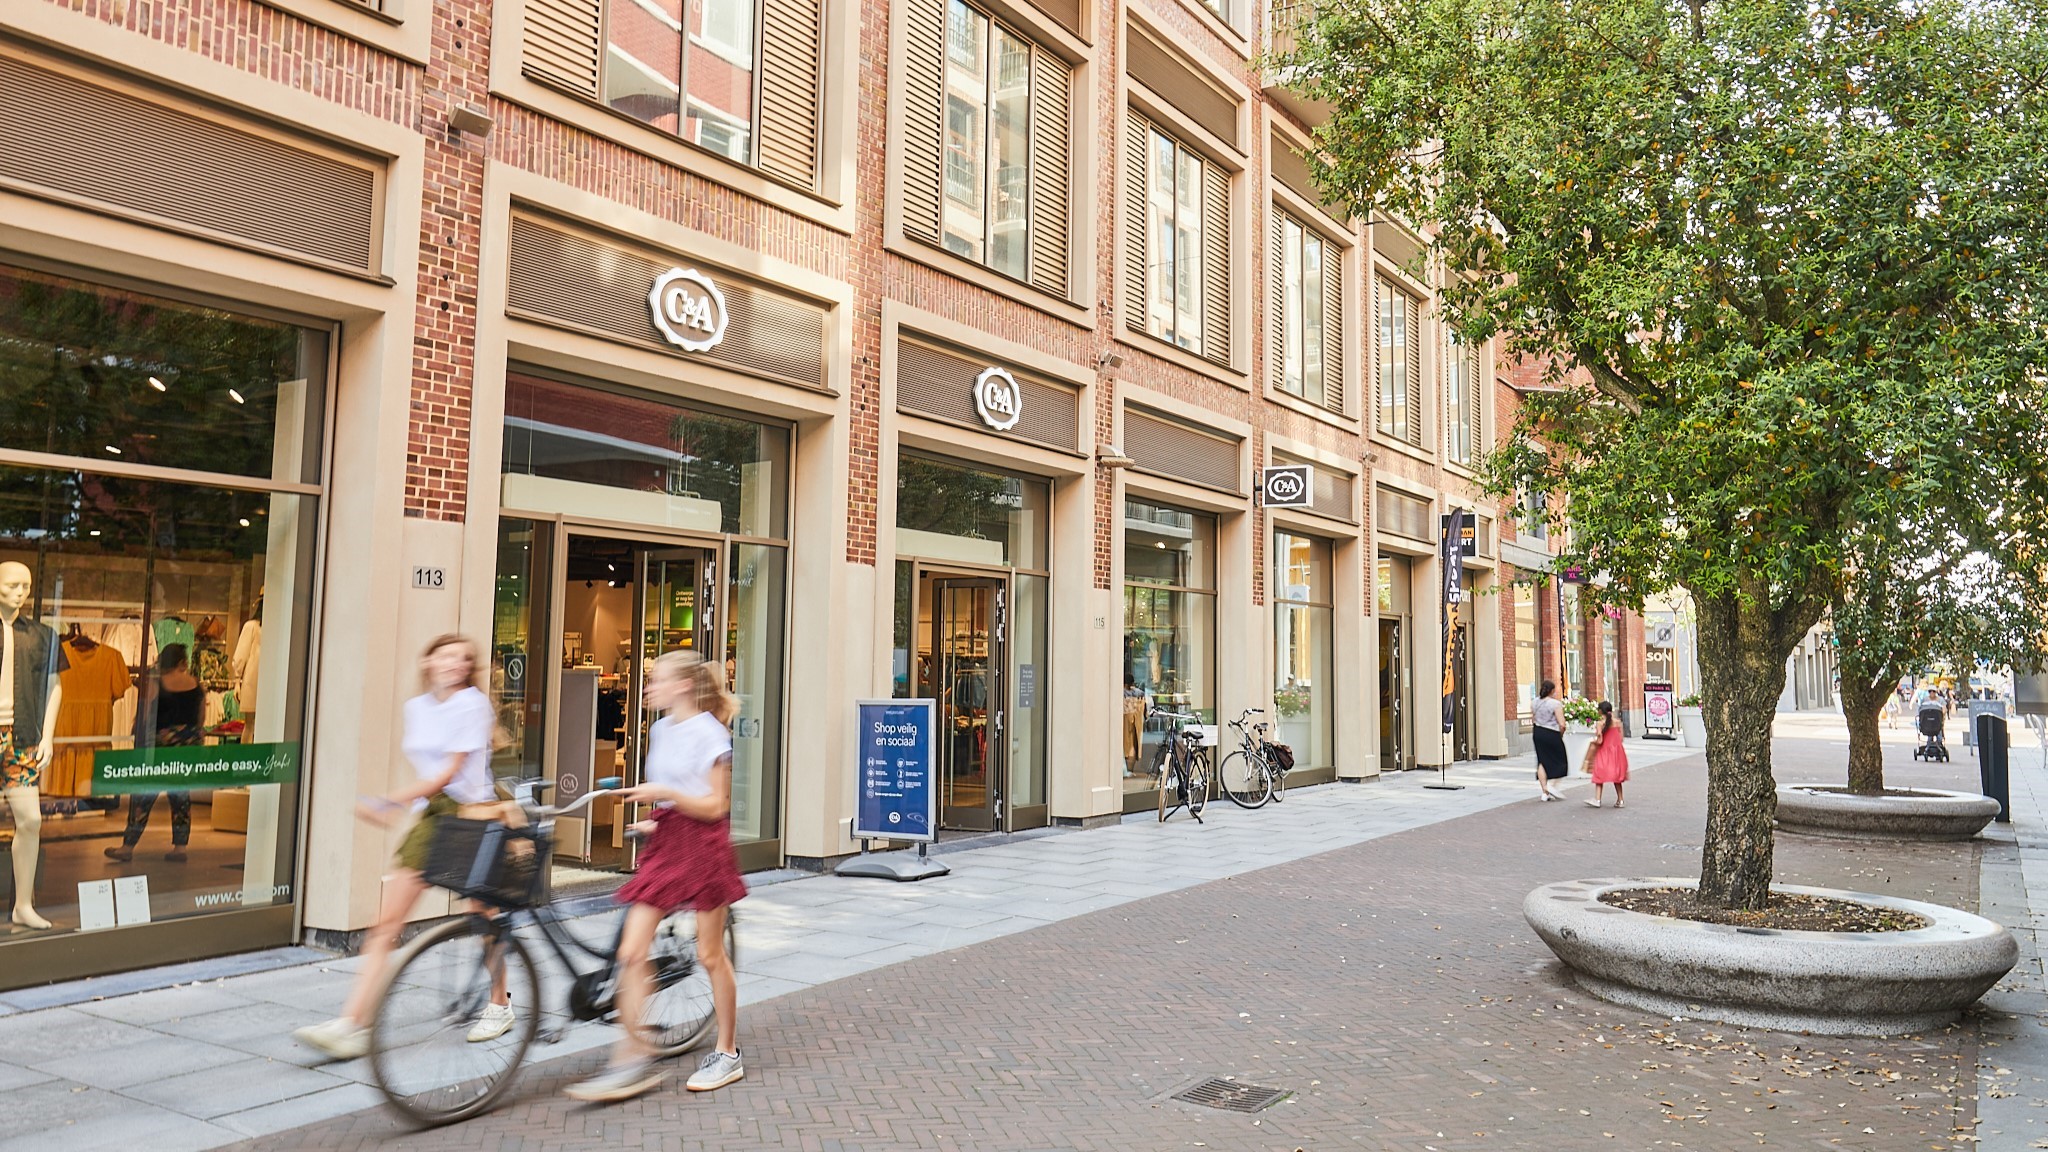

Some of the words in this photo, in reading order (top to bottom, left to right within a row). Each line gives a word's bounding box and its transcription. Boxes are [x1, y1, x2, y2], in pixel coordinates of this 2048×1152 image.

[665, 287, 716, 333] C&A
[984, 382, 1014, 415] C&A
[1274, 479, 1297, 493] C&A
[416, 568, 443, 586] 113
[1095, 617, 1105, 627] 115
[874, 721, 896, 735] Shop
[897, 722, 917, 736] veilig
[875, 737, 887, 746] en
[888, 735, 916, 747] sociaal
[103, 761, 193, 779] Sustainability
[195, 758, 229, 773] made
[232, 758, 262, 773] easy.
